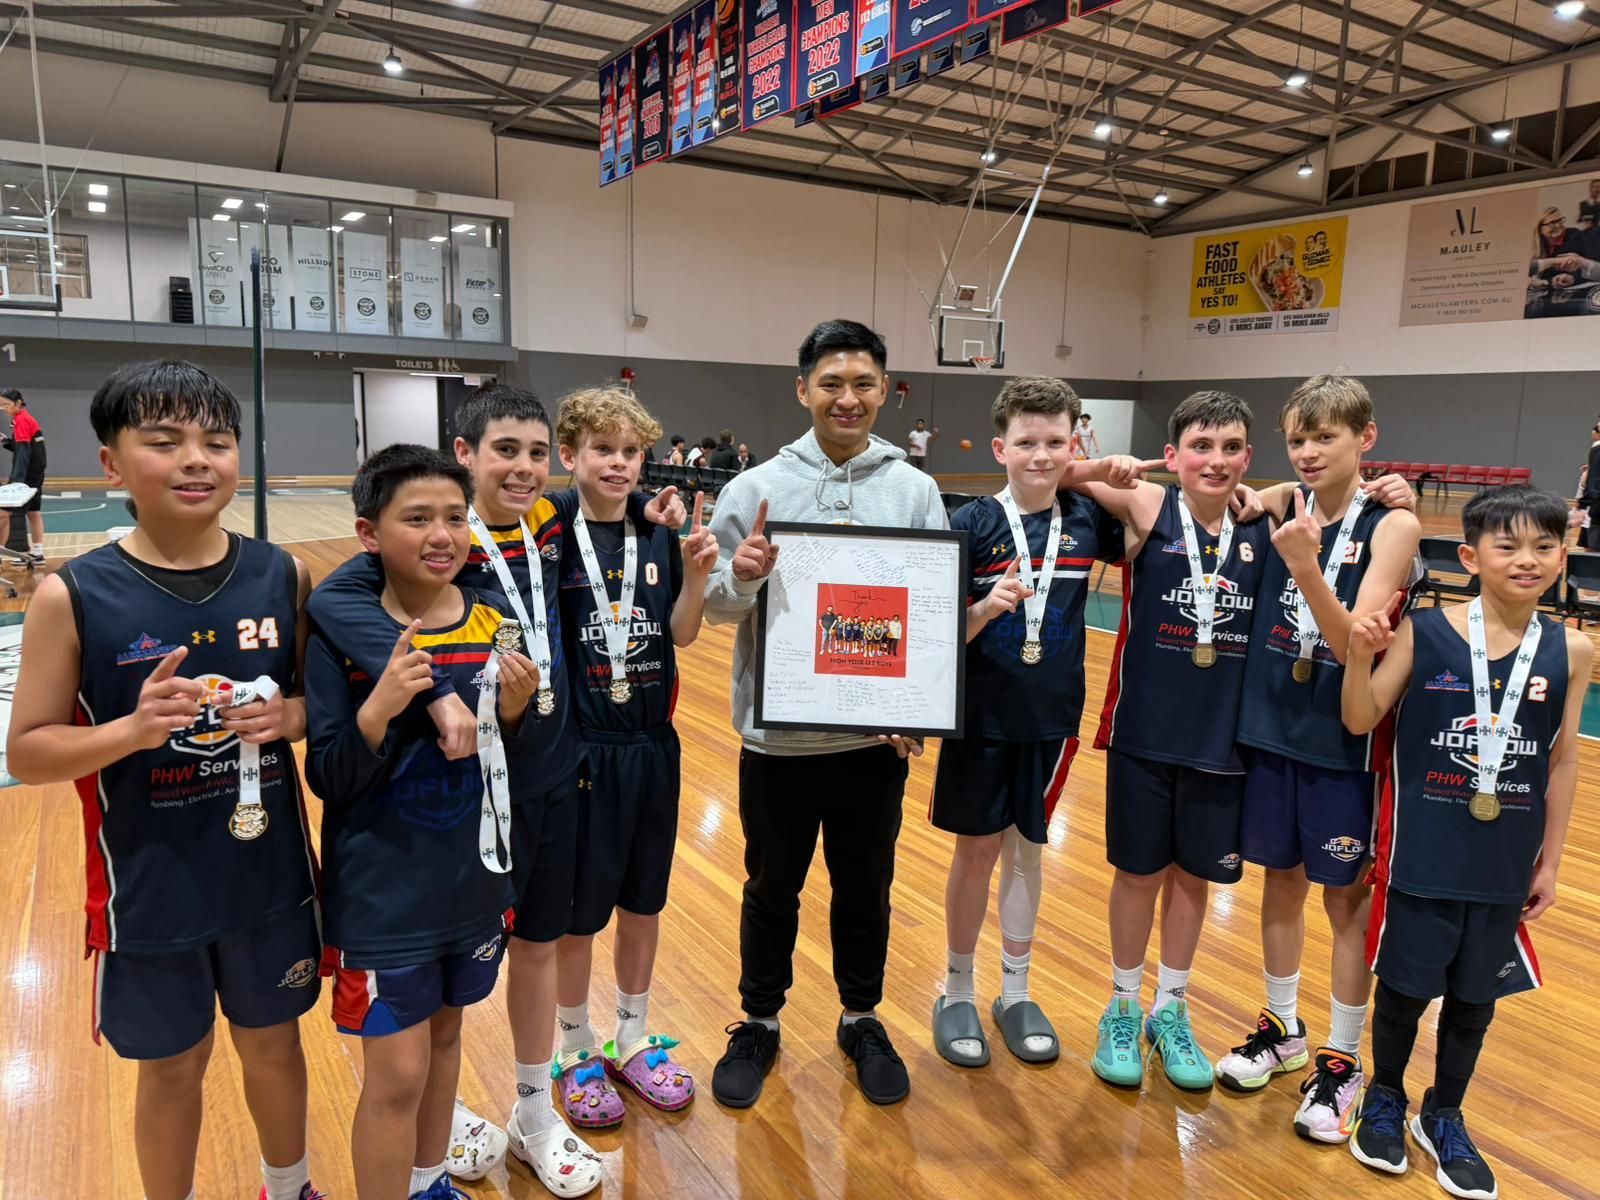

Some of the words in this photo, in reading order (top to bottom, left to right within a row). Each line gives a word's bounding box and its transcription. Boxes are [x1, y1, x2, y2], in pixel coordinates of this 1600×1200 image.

[801, 11, 849, 51] CHAMPIONS
[748, 41, 785, 74] CHAMPIONS
[808, 38, 840, 75] 2022
[752, 64, 781, 99] 2022
[1206, 241, 1240, 260] FAST
[352, 271, 380, 279] STONE
[1205, 258, 1238, 275] FOOD
[1196, 272, 1246, 288] ATHLETES
[1201, 296, 1219, 308] YES
[1222, 294, 1239, 306] TO!
[1213, 287, 1226, 296] SAY
[395, 359, 433, 370] TOILETS
[1239, 541, 1254, 562] 6
[1342, 541, 1364, 564] 21
[645, 562, 659, 586] 0
[236, 616, 280, 651] 24
[1157, 622, 1194, 638] PHW
[1527, 675, 1549, 703] 2
[151, 763, 196, 785] PHW
[1425, 771, 1468, 787] PHW
